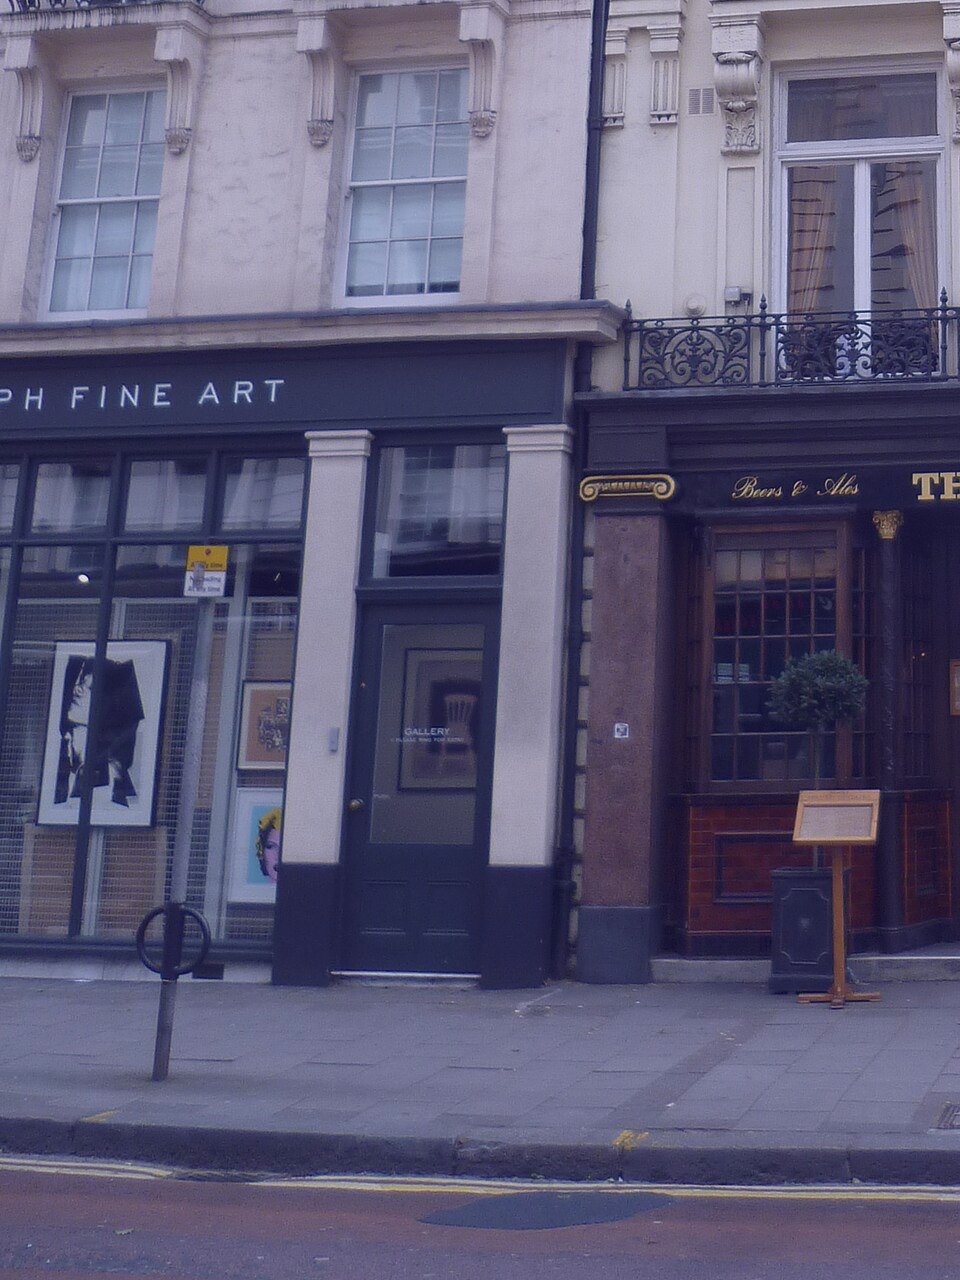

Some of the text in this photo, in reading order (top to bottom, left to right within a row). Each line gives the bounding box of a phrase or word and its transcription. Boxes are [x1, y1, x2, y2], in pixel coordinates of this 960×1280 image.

[71, 383, 172, 409] FINE
[198, 379, 285, 404] ART
[731, 472, 859, 498] Beers & Ales
[404, 727, 450, 736] GALLERY
